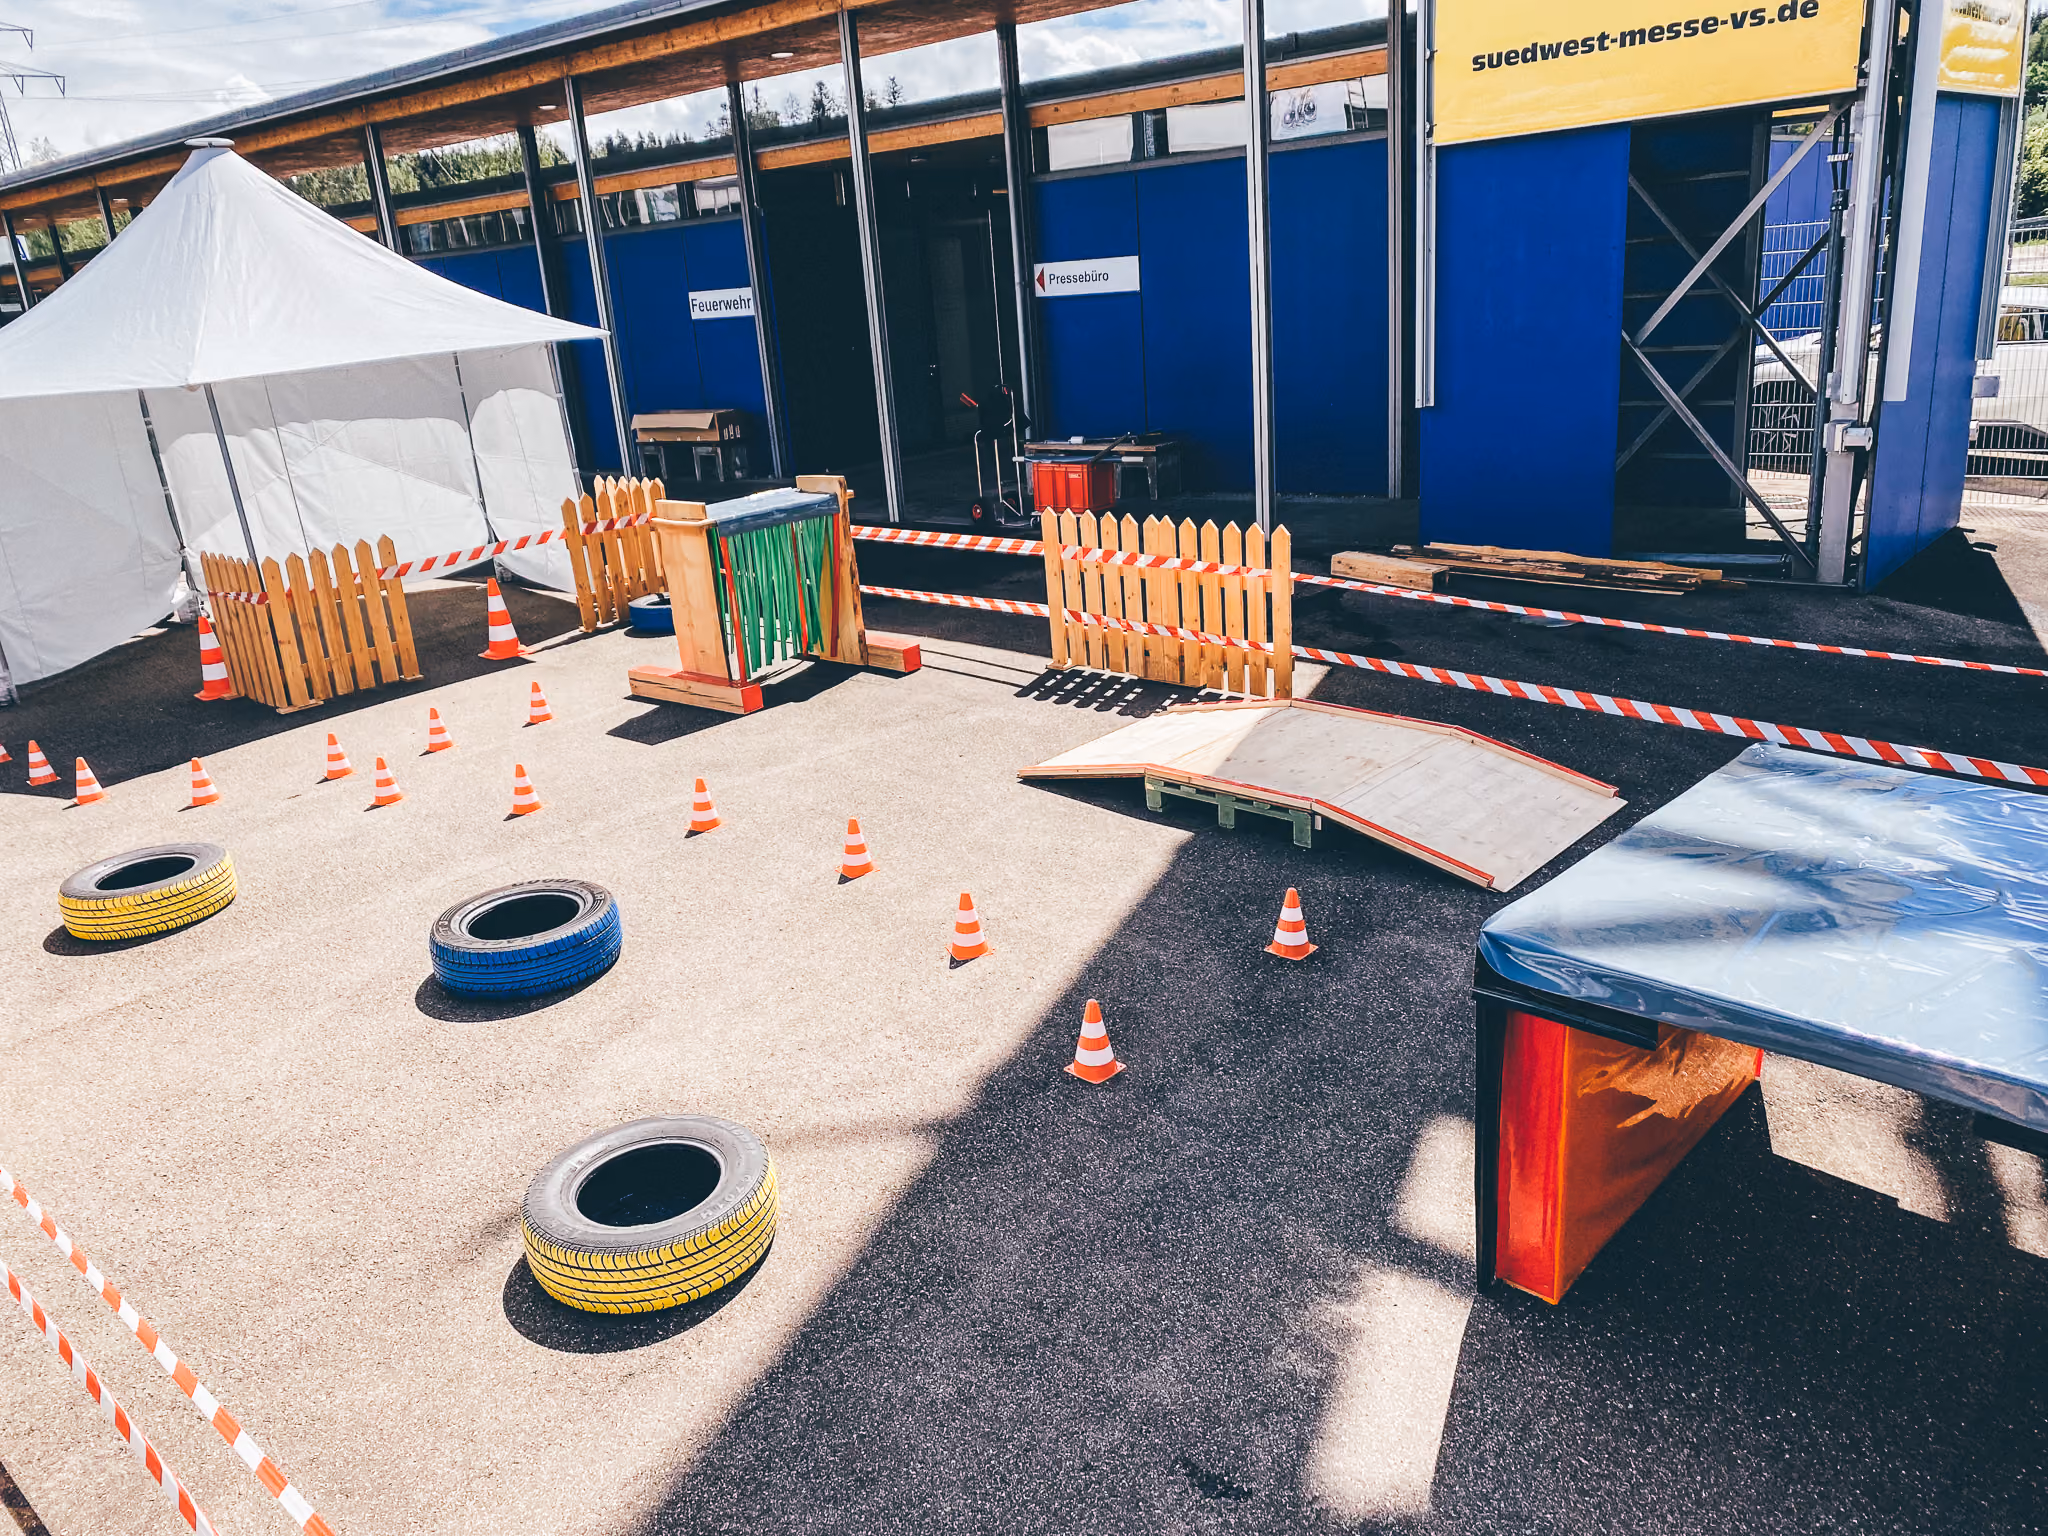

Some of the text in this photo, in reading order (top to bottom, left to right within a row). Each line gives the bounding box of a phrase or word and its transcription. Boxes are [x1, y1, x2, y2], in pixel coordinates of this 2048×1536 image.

[1472, 0, 1819, 71] suedwest-messe-vs.de
[1049, 270, 1109, 285] Pressebüro
[691, 295, 751, 312] Feuerwehr
